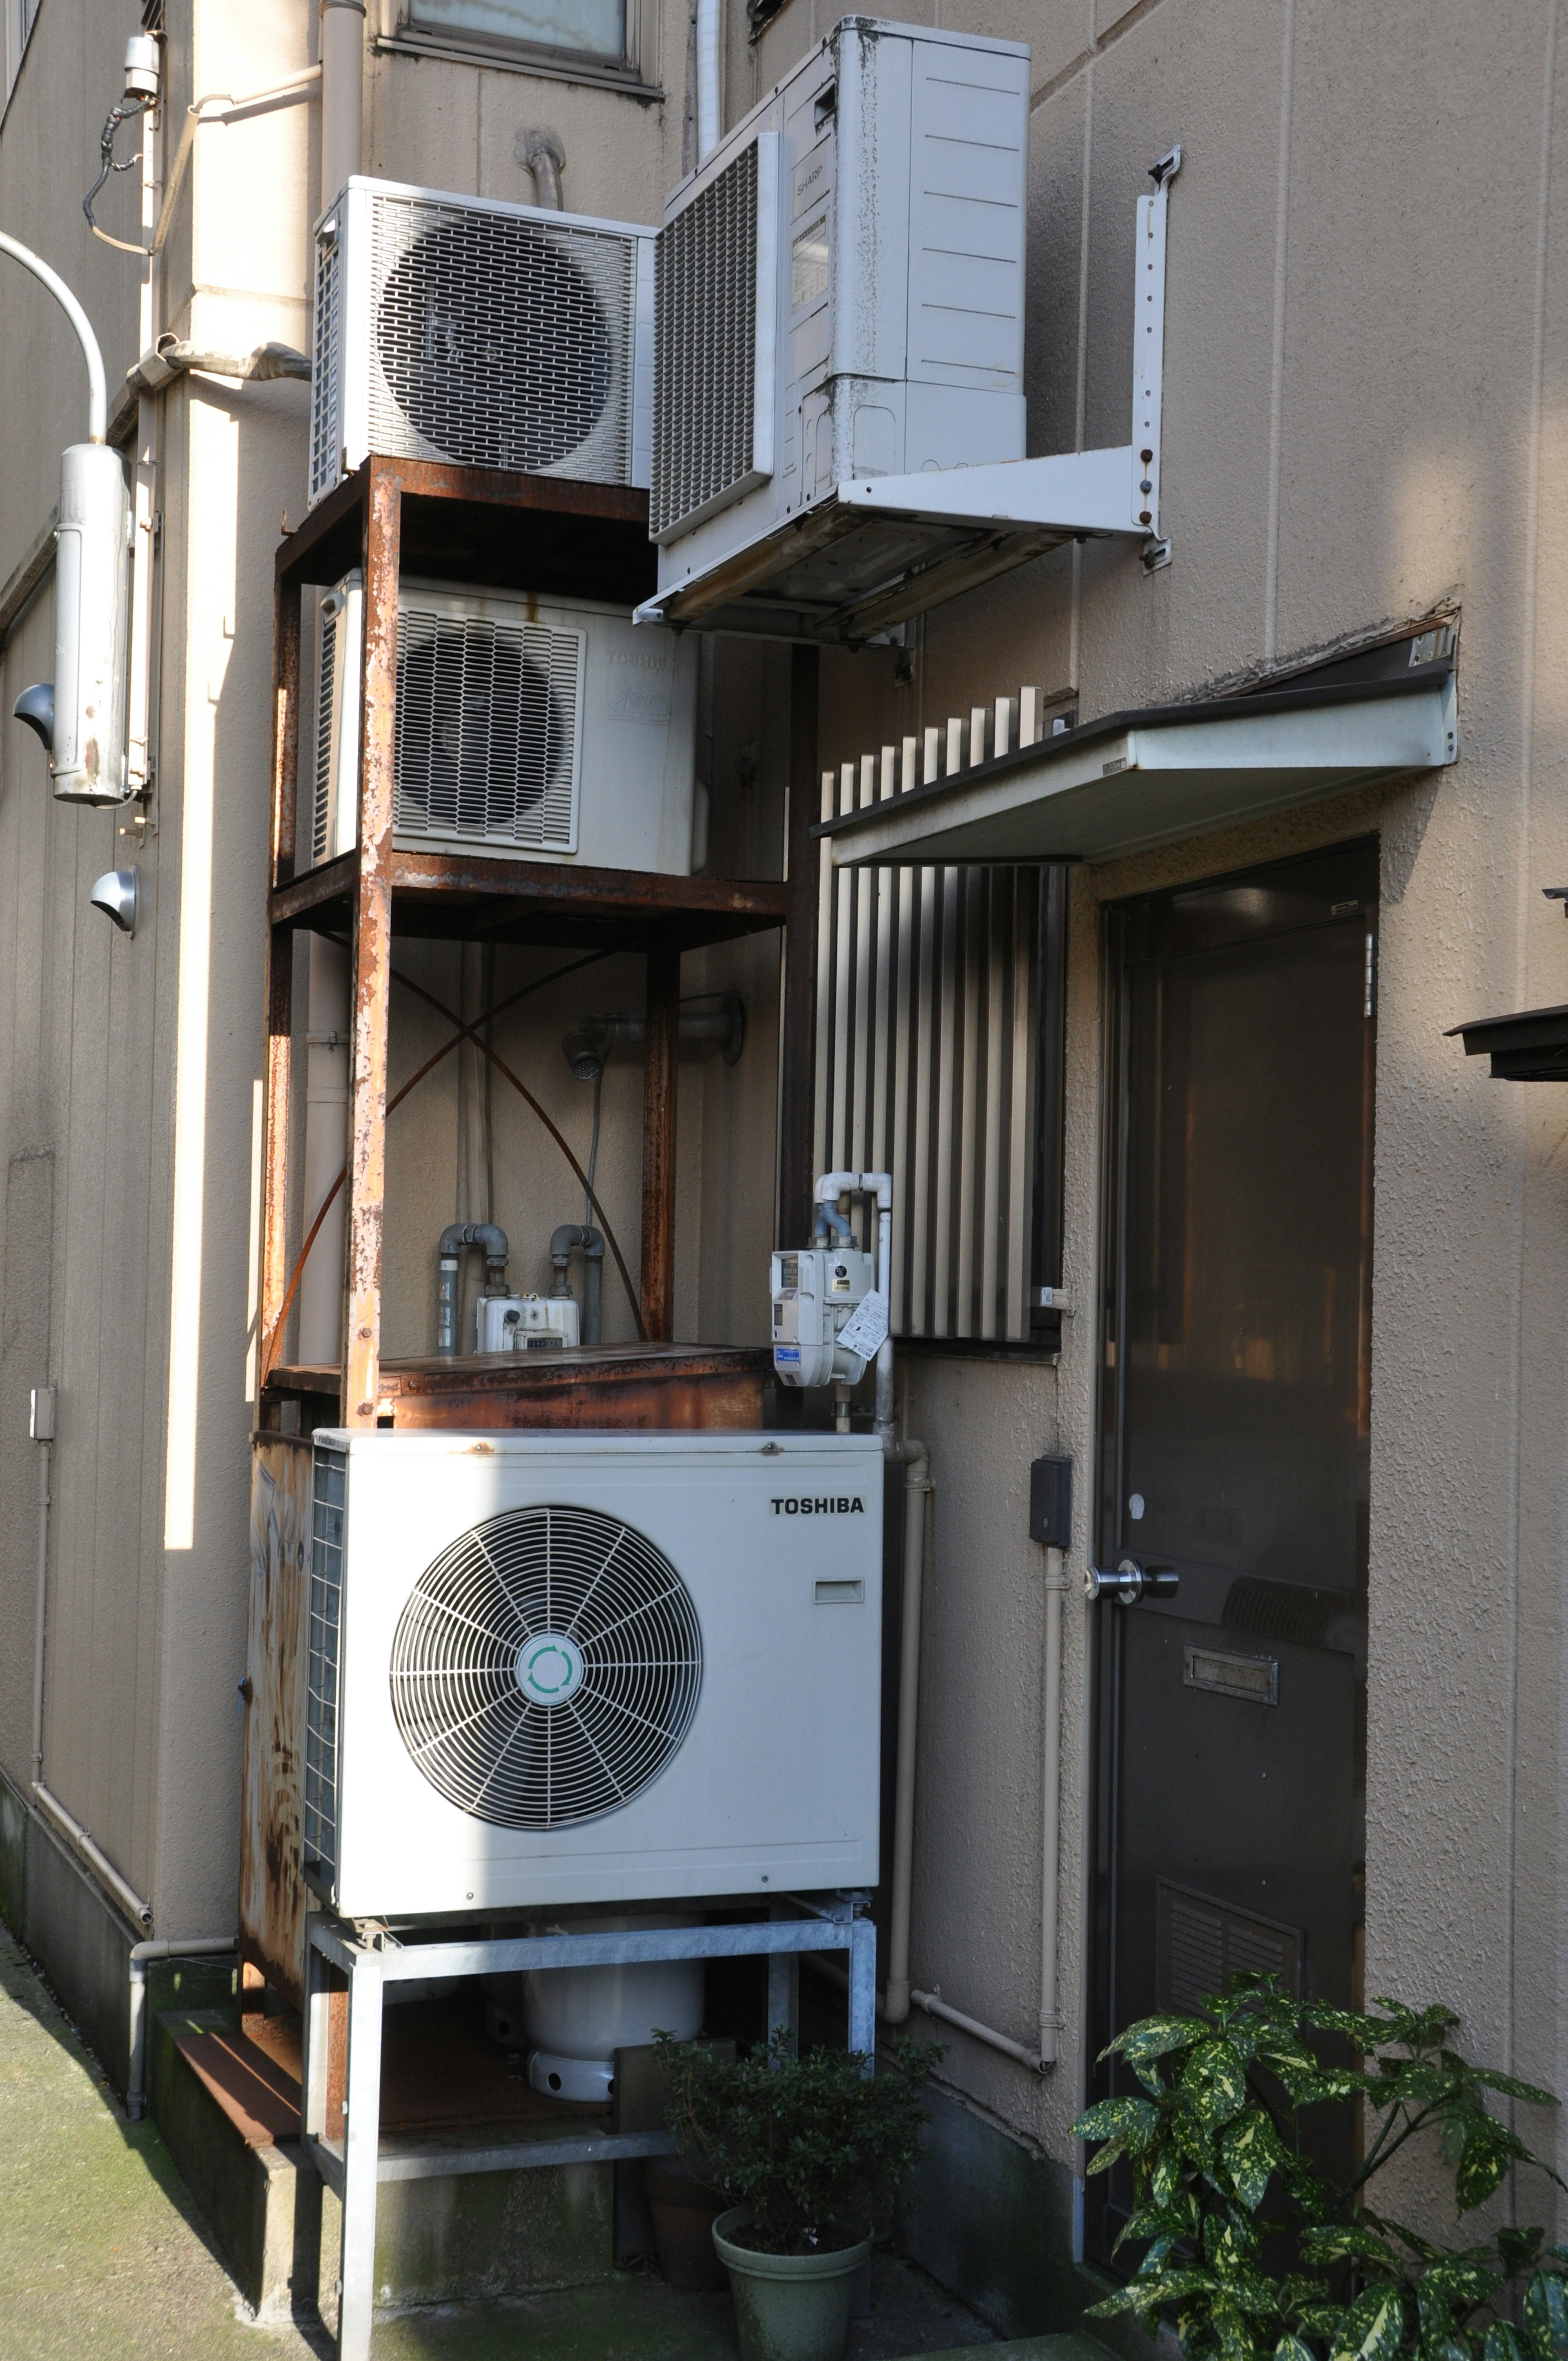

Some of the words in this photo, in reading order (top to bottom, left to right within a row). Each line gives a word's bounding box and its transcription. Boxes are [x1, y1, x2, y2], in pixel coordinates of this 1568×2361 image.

[797, 165, 822, 196] SHARP
[605, 650, 678, 671] TOSHIBA
[771, 1497, 864, 1515] TOSHIBA
